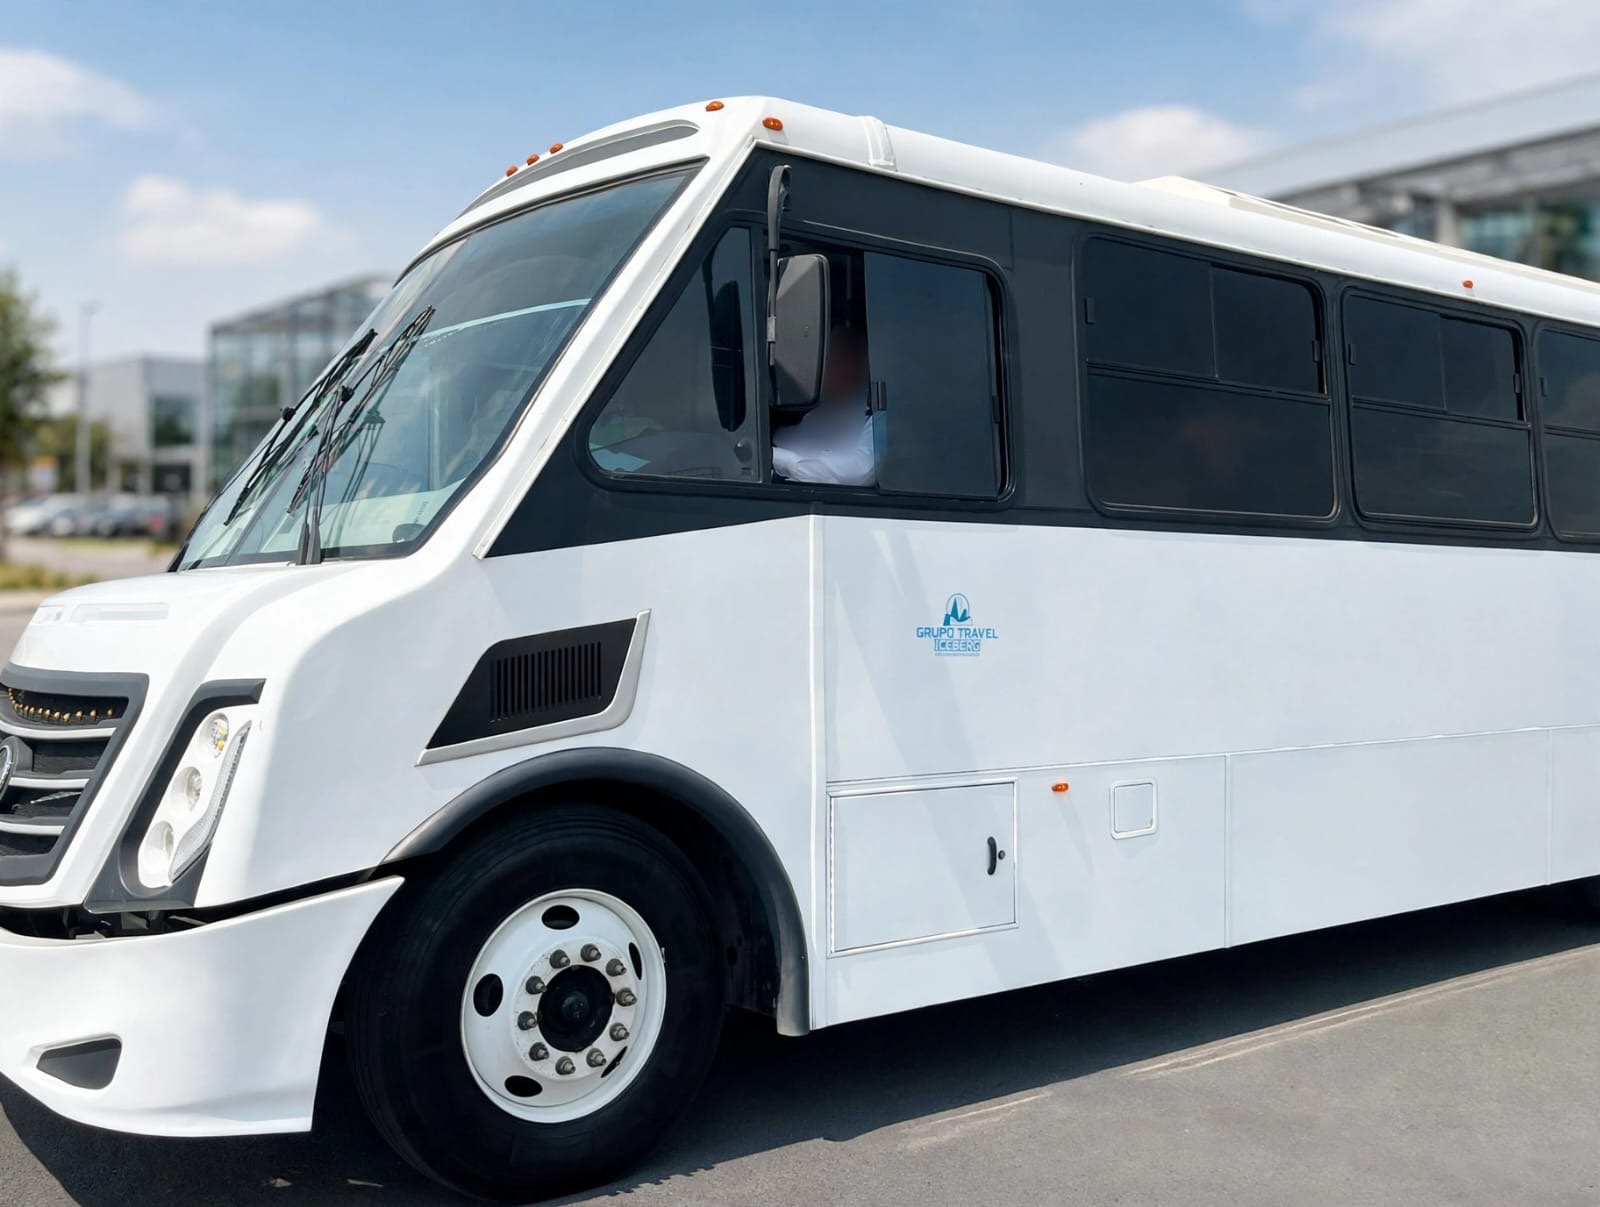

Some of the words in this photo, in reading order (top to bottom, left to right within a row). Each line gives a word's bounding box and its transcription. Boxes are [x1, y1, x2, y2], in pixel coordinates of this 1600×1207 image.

[916, 627, 954, 638] GRUPO
[958, 628, 998, 639] TRAVEL
[935, 639, 981, 651] ICEBERG
